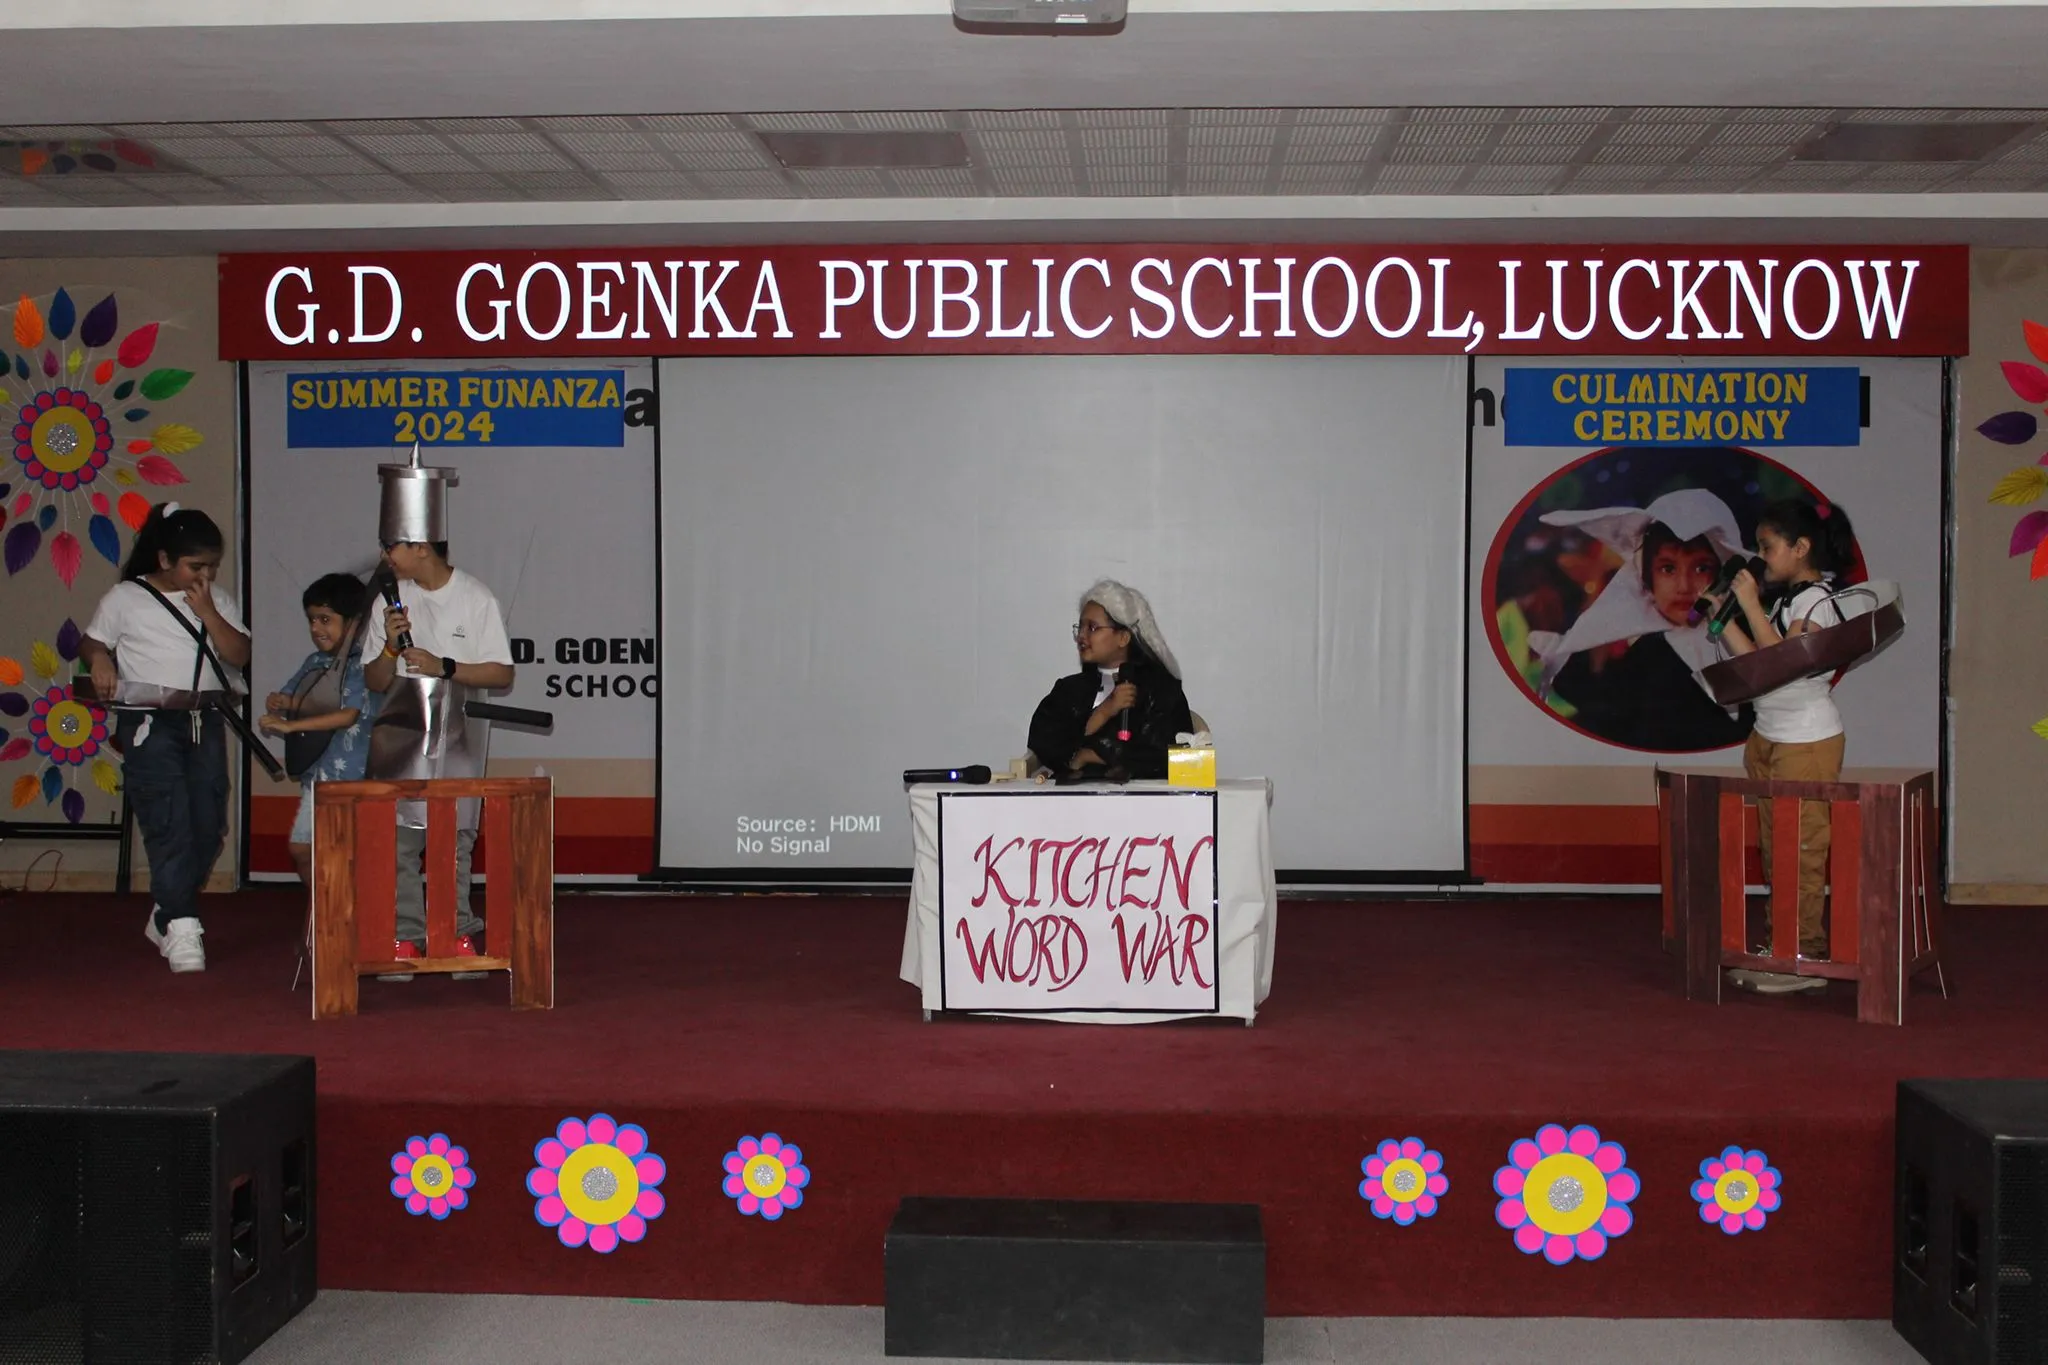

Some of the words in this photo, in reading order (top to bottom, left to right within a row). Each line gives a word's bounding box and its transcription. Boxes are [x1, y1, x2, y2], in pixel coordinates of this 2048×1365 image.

[265, 265, 423, 345] G.D.
[456, 261, 794, 341] GOENKA
[819, 258, 1114, 338] PUBLIC
[1129, 256, 1485, 352] SCHOOL,
[1499, 258, 1920, 341] LUCKNOW
[292, 377, 449, 410] SUMMER
[459, 377, 620, 408] FUNANZA
[1552, 372, 1808, 404] CULMINATION
[394, 411, 495, 443] 2024
[1573, 409, 1791, 441] CEREMONY
[737, 816, 816, 833] Source:
[830, 816, 881, 833] HDMI
[737, 837, 763, 853] No
[770, 836, 830, 855] Signal
[971, 834, 1214, 912] KITCHEN
[956, 905, 1089, 992] WORD
[1110, 911, 1214, 989] WAR
